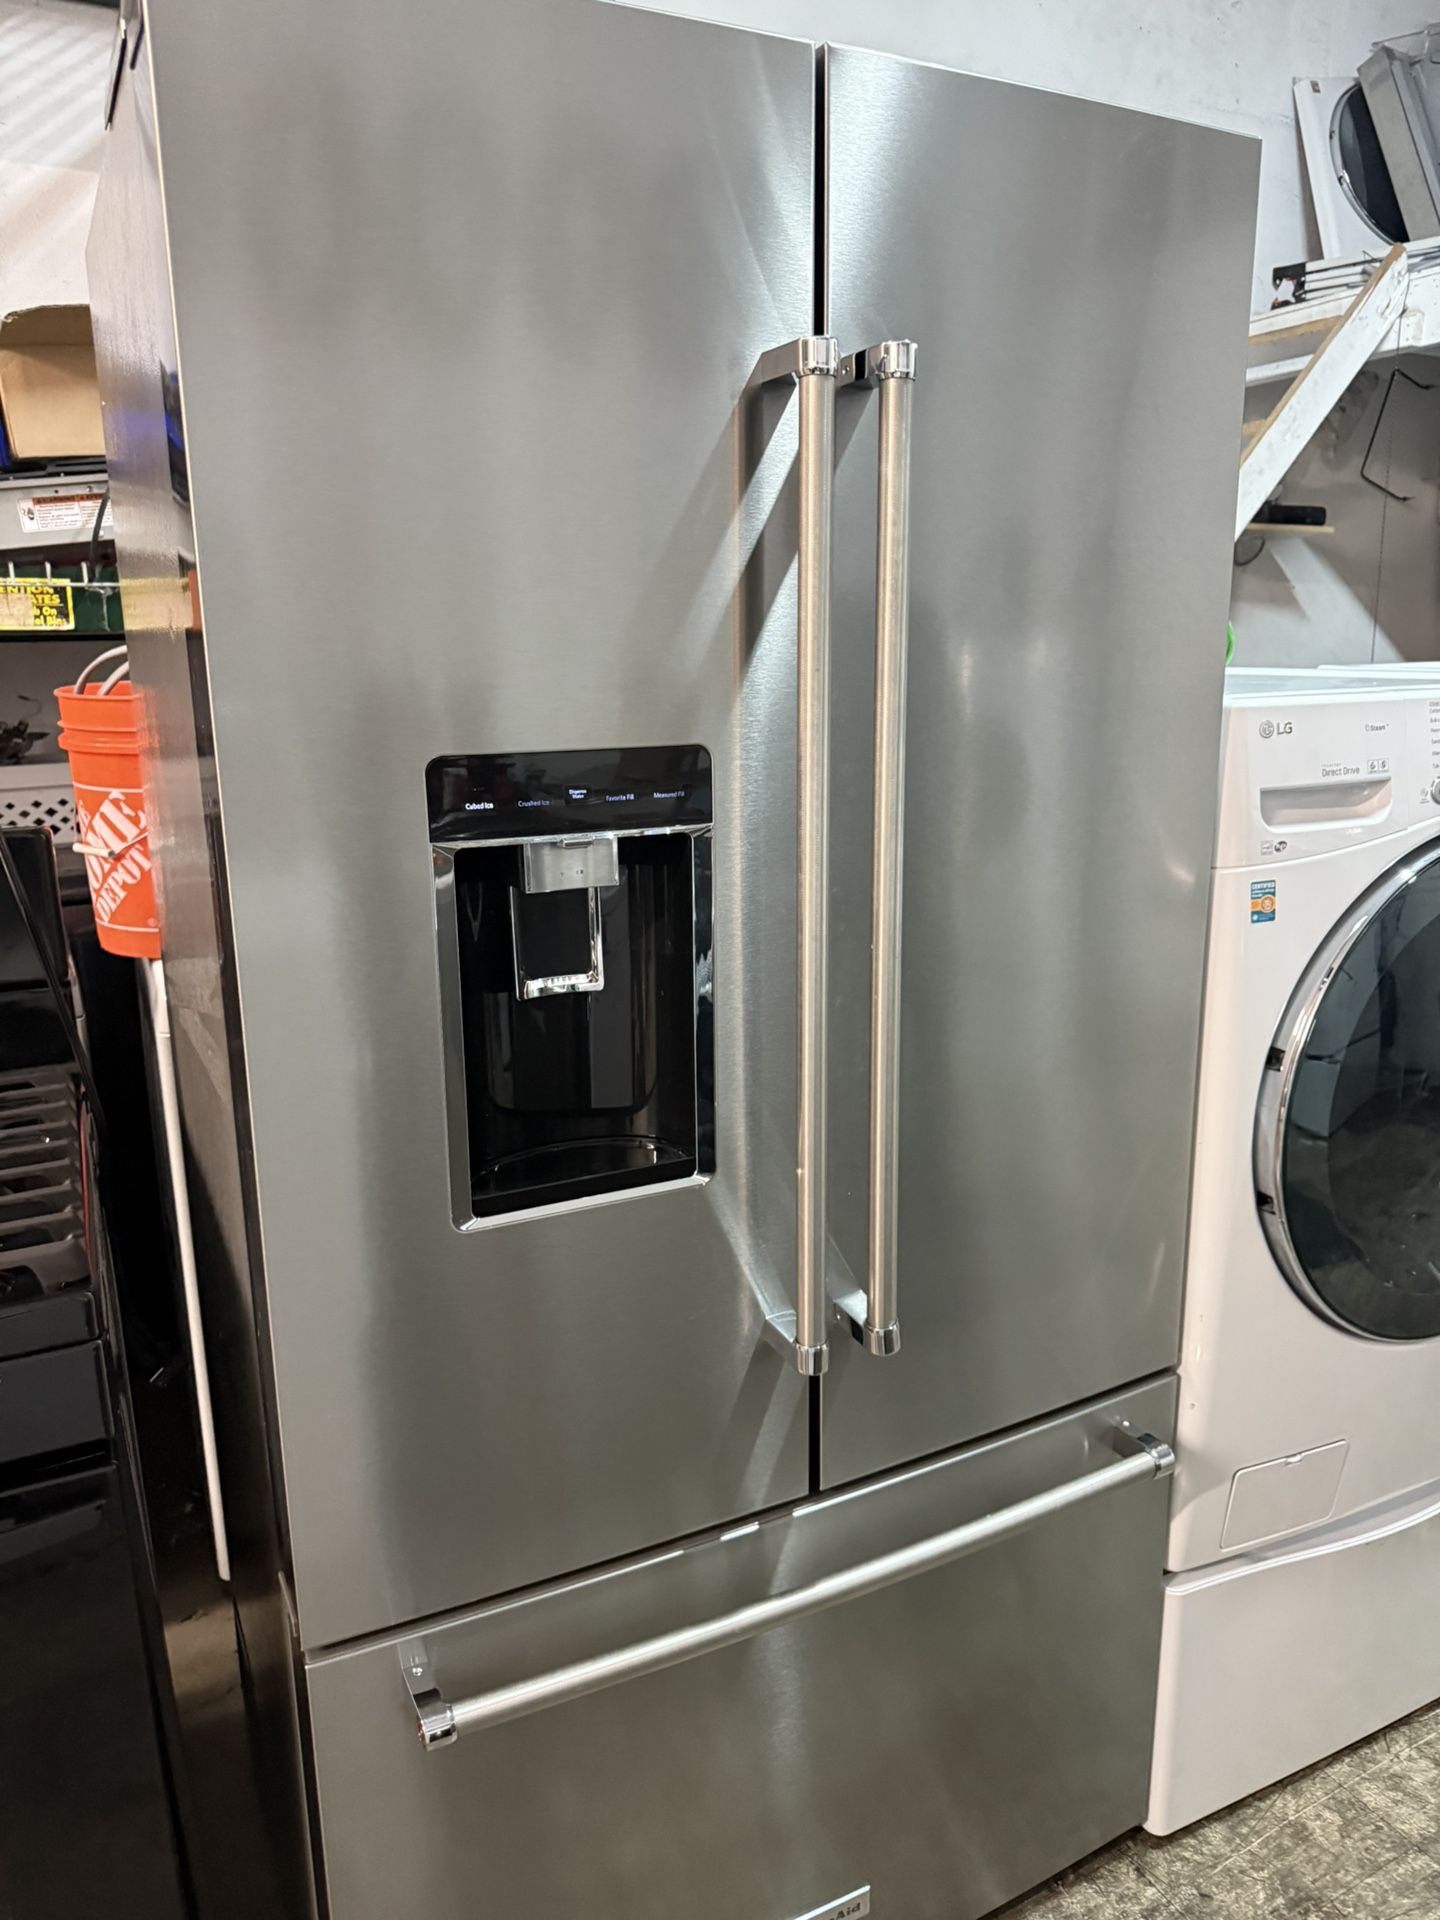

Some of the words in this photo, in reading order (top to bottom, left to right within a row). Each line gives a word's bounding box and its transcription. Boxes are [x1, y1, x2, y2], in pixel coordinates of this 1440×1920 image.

[1276, 721, 1293, 735] LG
[1321, 768, 1342, 777] Direct
[1343, 766, 1360, 775] Drive
[605, 794, 626, 802] Favorite
[653, 790, 678, 799] Measured
[465, 802, 484, 810] Cubed
[517, 799, 541, 808] Crushed
[95, 843, 151, 924] DEPOT
